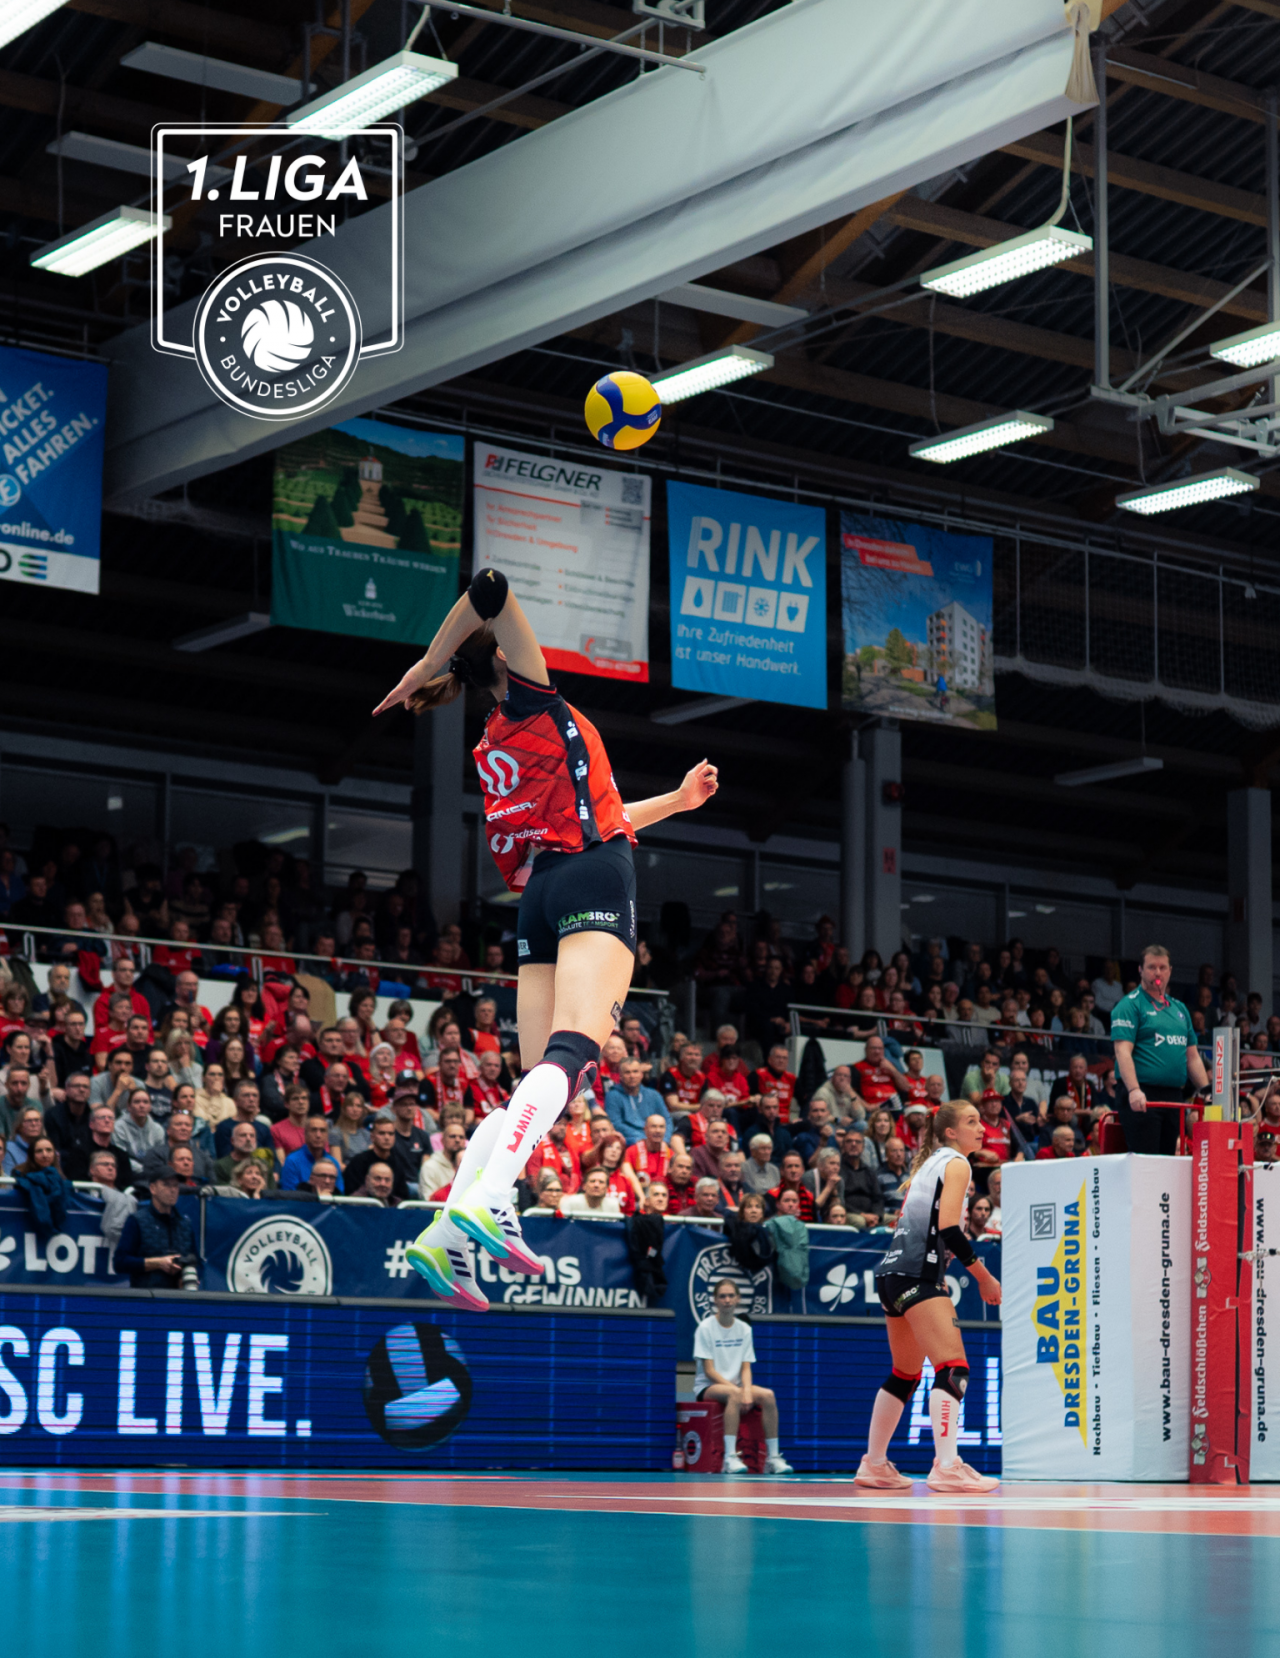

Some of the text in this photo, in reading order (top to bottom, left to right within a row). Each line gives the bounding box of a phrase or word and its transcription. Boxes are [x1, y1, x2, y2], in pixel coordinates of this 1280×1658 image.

[2, 410, 57, 465] ALLES
[15, 413, 98, 485] FAHREN.
[504, 458, 602, 491] FELGNER
[687, 516, 820, 588] RINK
[675, 644, 691, 660] ist
[696, 649, 732, 665] unser
[677, 624, 795, 653] Ihre Zufriedenheit
[1216, 1040, 1224, 1094] BENZ
[1091, 1167, 1100, 1239] Gerüstbau
[244, 1231, 317, 1267] VOLLEYBALL
[1092, 1264, 1101, 1306] Fliesen
[1036, 1266, 1060, 1364] BAU
[1063, 1201, 1081, 1428] DRESDEN-GRUNA
[1160, 1192, 1172, 1442] www.bau-dresden-gruna.de
[1092, 1331, 1101, 1377] Tiefbau
[117, 1330, 312, 1437] LIVE.
[1092, 1395, 1101, 1456] Hochbau
